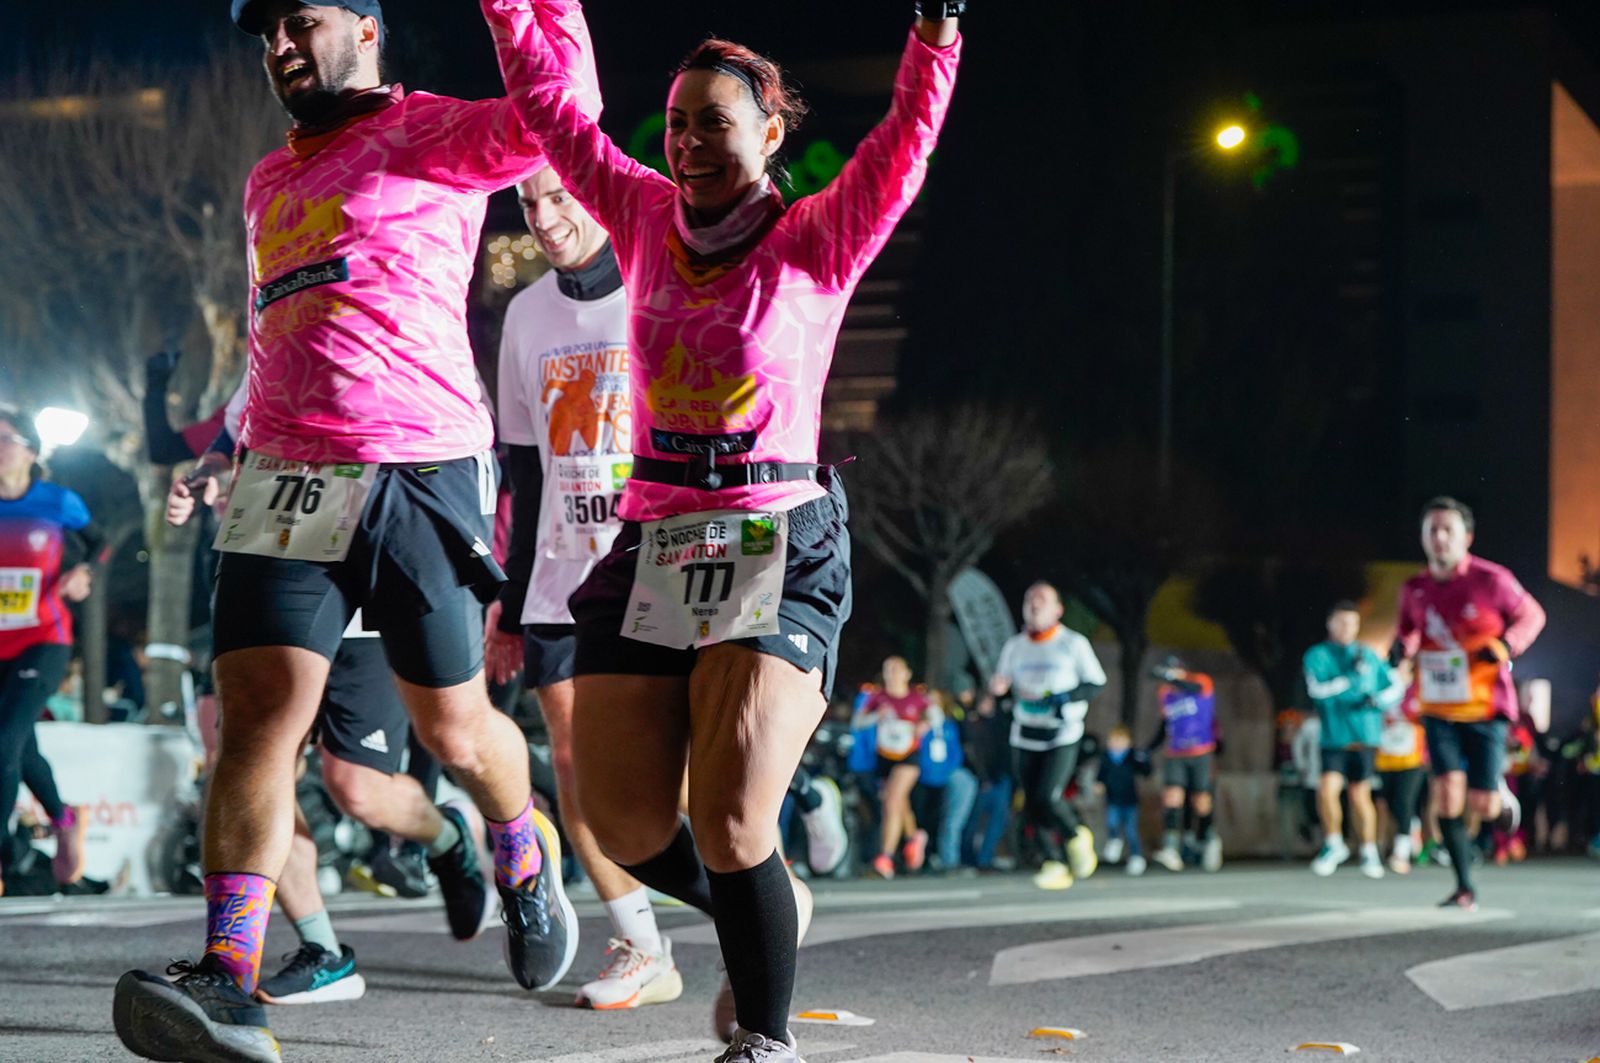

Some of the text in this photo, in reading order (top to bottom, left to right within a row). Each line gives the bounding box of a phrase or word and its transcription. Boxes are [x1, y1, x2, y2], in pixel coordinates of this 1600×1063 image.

[263, 265, 338, 302] CaixaBank
[543, 350, 629, 384] INSTANTE
[671, 434, 748, 456] CaixBank
[267, 475, 325, 515] 776
[564, 495, 620, 524] 3504
[671, 526, 706, 547] NOCHE
[709, 526, 728, 539] DE
[655, 550, 683, 567] SAN
